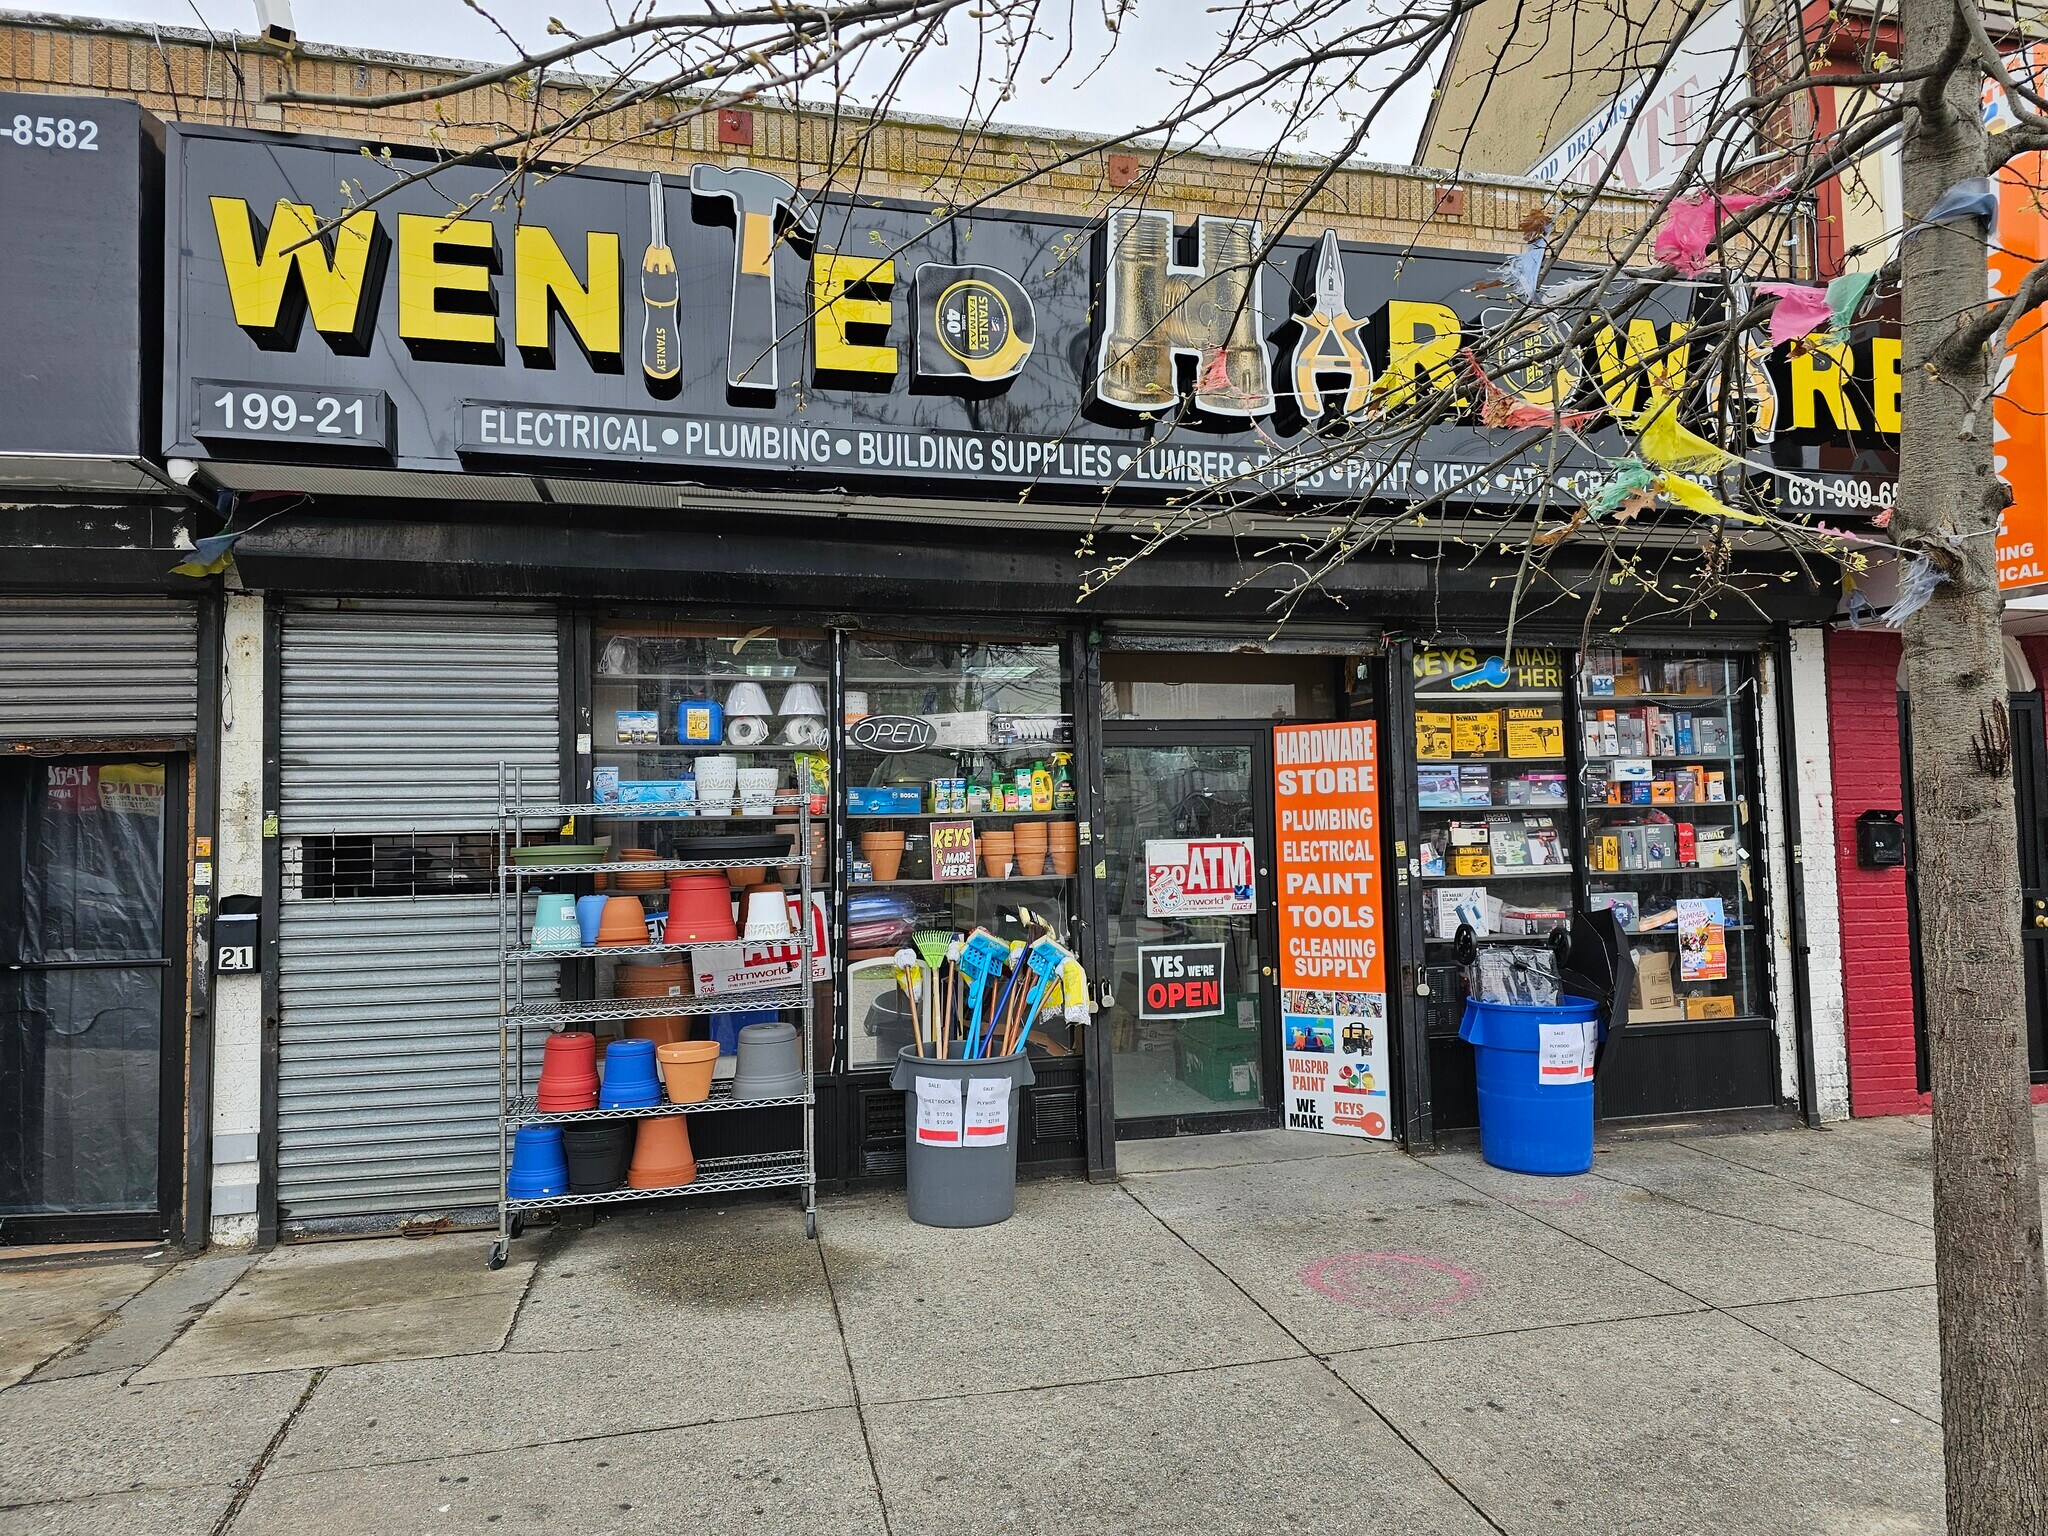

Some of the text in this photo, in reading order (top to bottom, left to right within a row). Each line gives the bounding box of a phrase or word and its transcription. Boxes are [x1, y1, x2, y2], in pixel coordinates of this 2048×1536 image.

[0, 114, 98, 150] -8582
[978, 296, 989, 350] STANLEY
[656, 327, 667, 372] STANLEY
[215, 391, 363, 435] 199-21
[481, 410, 658, 452] ELECTRICAL
[685, 421, 830, 463] PLUMBING
[859, 434, 983, 471] BUILDING
[991, 439, 1111, 477] SUPPLIES
[1136, 447, 1233, 483] LUMBER
[1347, 459, 1412, 491] PAINT
[1434, 462, 1490, 497] KEYS
[854, 722, 930, 743] OPEN
[998, 722, 1011, 730] LED
[1276, 726, 1374, 765] HARDWARE
[1278, 766, 1375, 795] STORE
[1282, 807, 1373, 831] PLUMBING
[933, 826, 971, 849] KEYS
[945, 852, 971, 864] MADE
[1283, 840, 1374, 863] ELECTRICAL
[941, 864, 974, 877] HERE
[1187, 846, 1247, 890] ATM
[1286, 872, 1372, 895] PAINT
[1288, 905, 1375, 928] TOOLS
[1680, 911, 1706, 921] SUMMER
[221, 948, 248, 968] 21
[1289, 937, 1376, 959] CLEANING
[1151, 955, 1215, 979] YES WE'RE
[1294, 958, 1371, 979] SUPPLY
[1147, 980, 1218, 1009] OPEN
[1288, 1058, 1329, 1075] VALSPAR
[1292, 1075, 1325, 1092] PAINT
[1296, 1098, 1364, 1116] WE KEYS
[1289, 1113, 1324, 1130] MAKE
